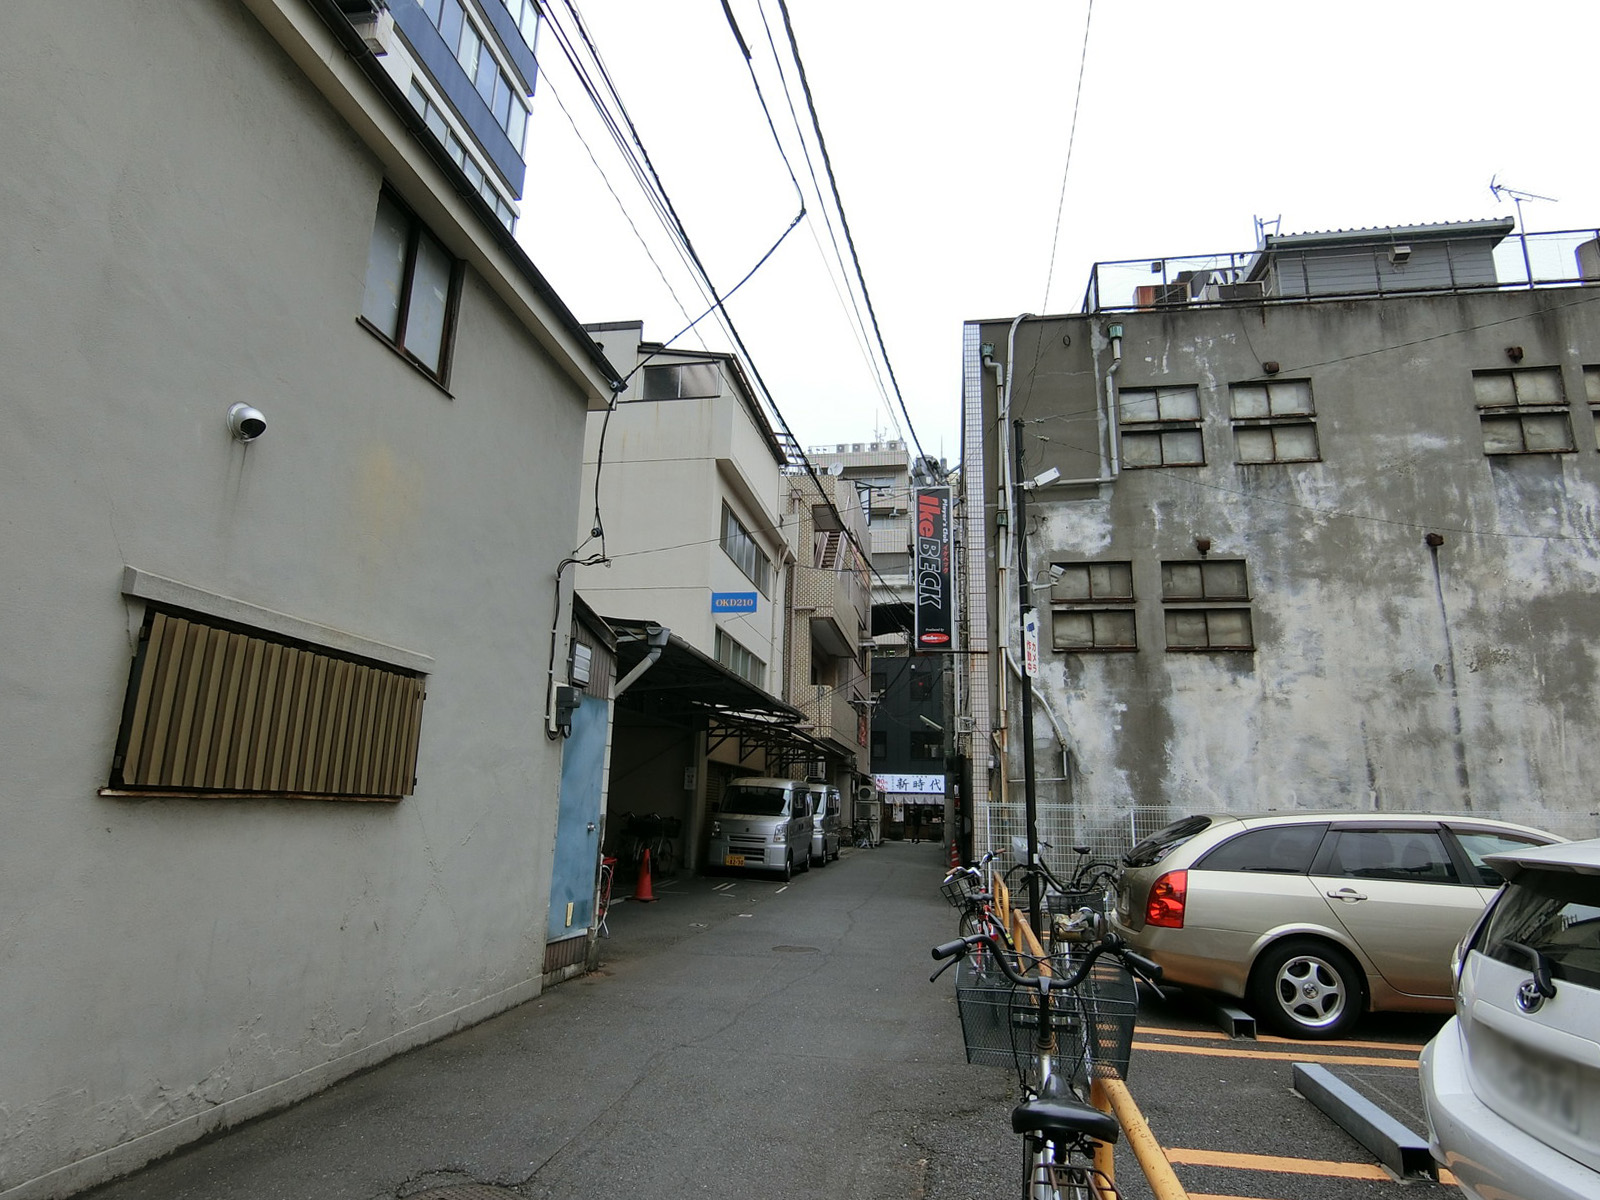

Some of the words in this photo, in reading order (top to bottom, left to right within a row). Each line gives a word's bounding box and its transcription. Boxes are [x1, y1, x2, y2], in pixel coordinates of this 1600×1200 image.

[941, 527, 949, 544] Club
[715, 598, 754, 607] OKD210
[895, 777, 942, 791] 新時代
